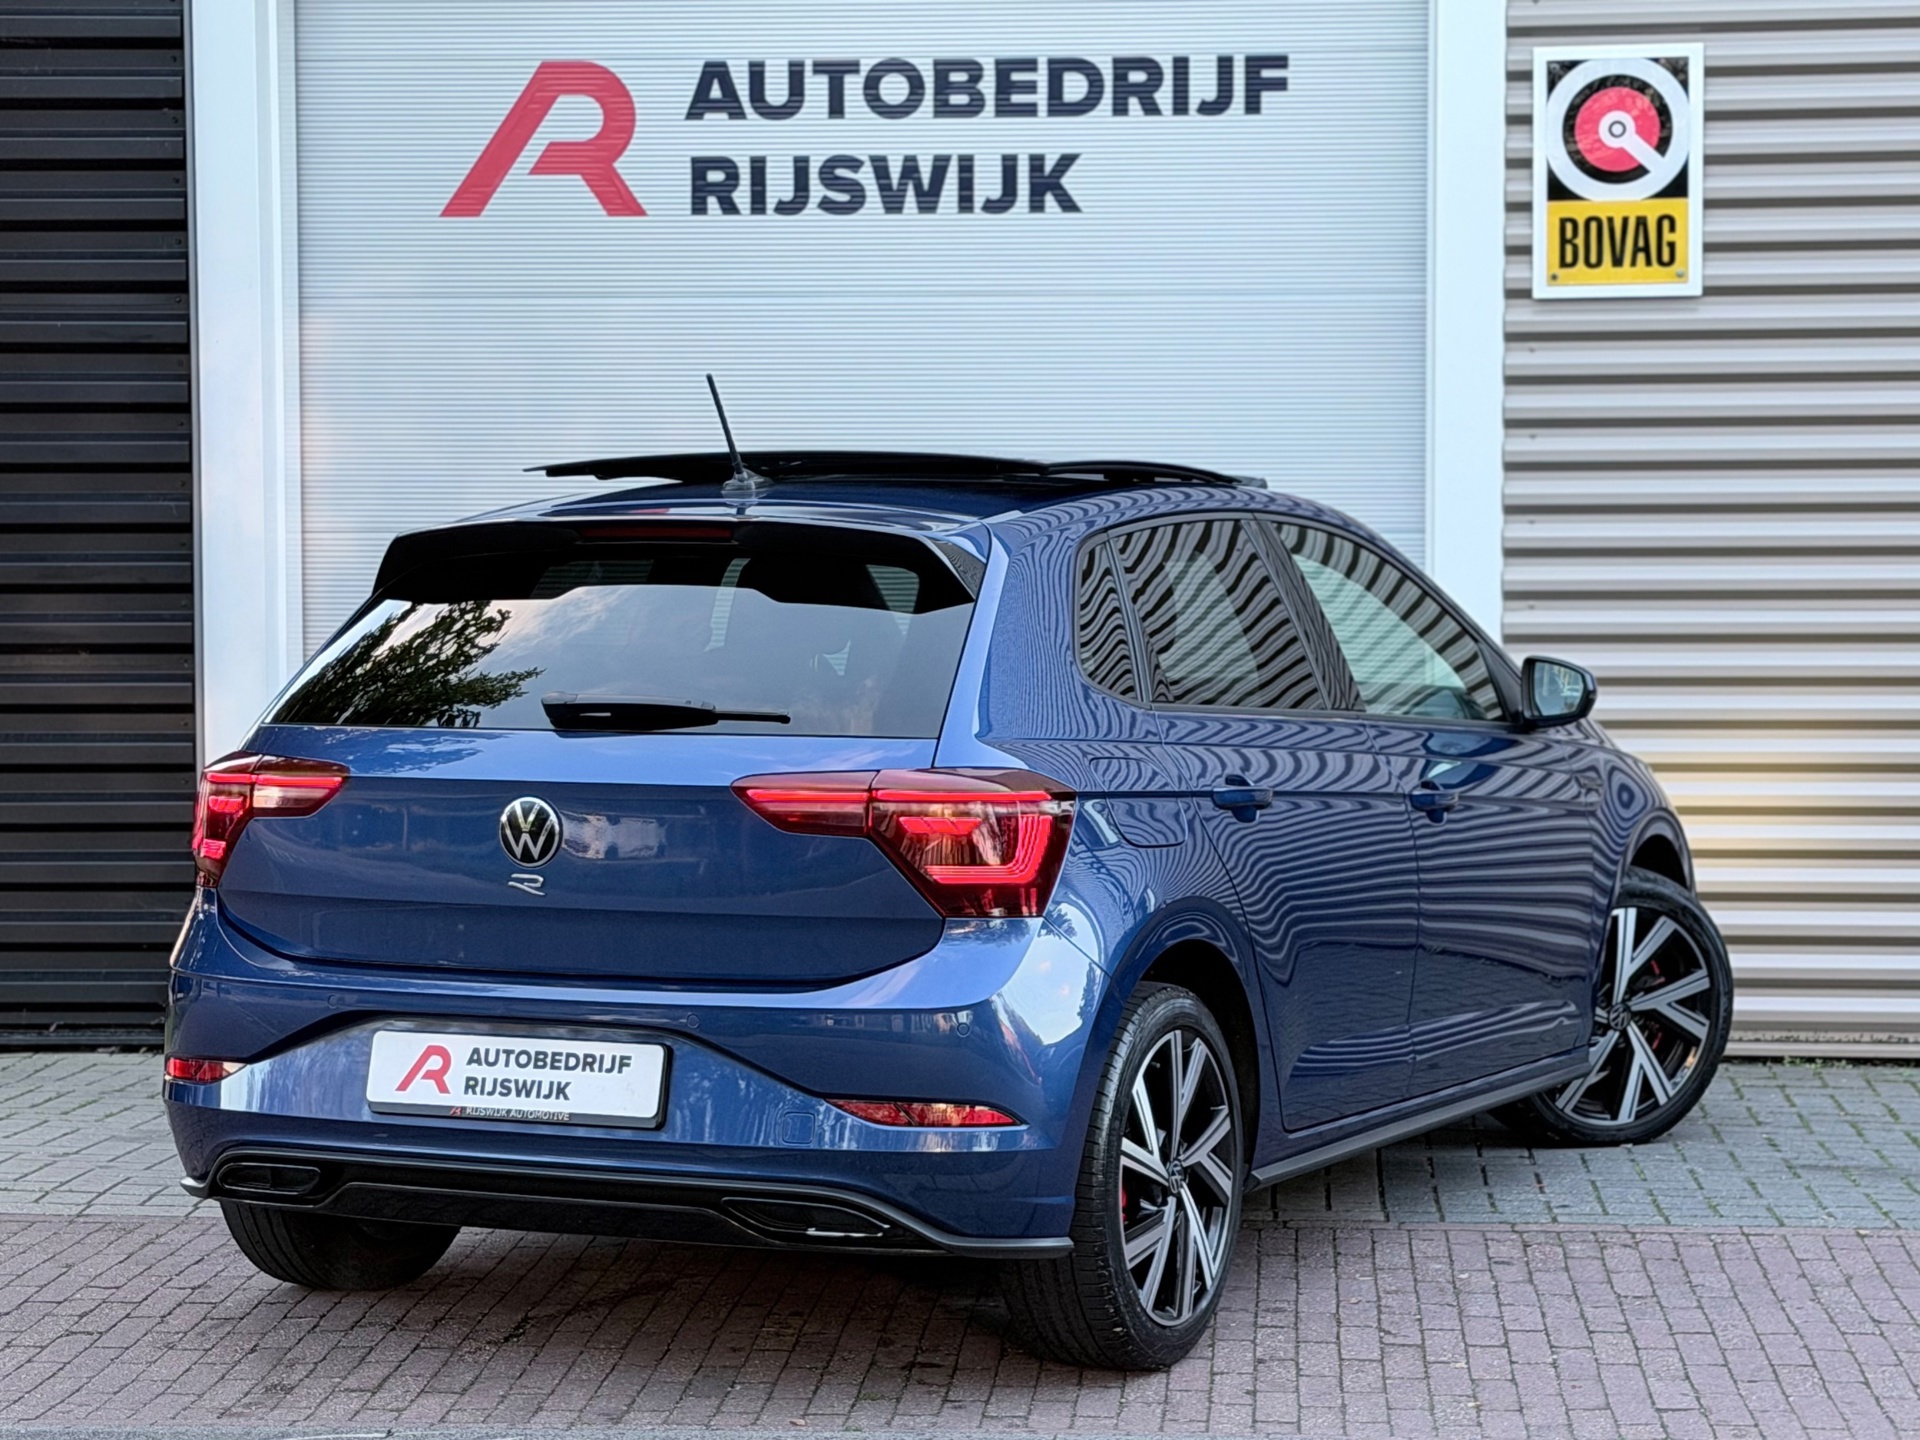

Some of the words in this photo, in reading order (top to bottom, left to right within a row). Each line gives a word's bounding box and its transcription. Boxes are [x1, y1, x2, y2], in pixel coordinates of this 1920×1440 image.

[685, 54, 1289, 120] AUTOBEDRIJF
[690, 154, 1083, 216] RIJSWIJK
[1558, 214, 1677, 269] BOVAG
[466, 1047, 632, 1075] AUTOBEDRIJF
[464, 1076, 571, 1101] RIJSWIJK
[465, 1106, 508, 1118] RIJSWIJK
[509, 1109, 571, 1121] AUTOMOTIVE
